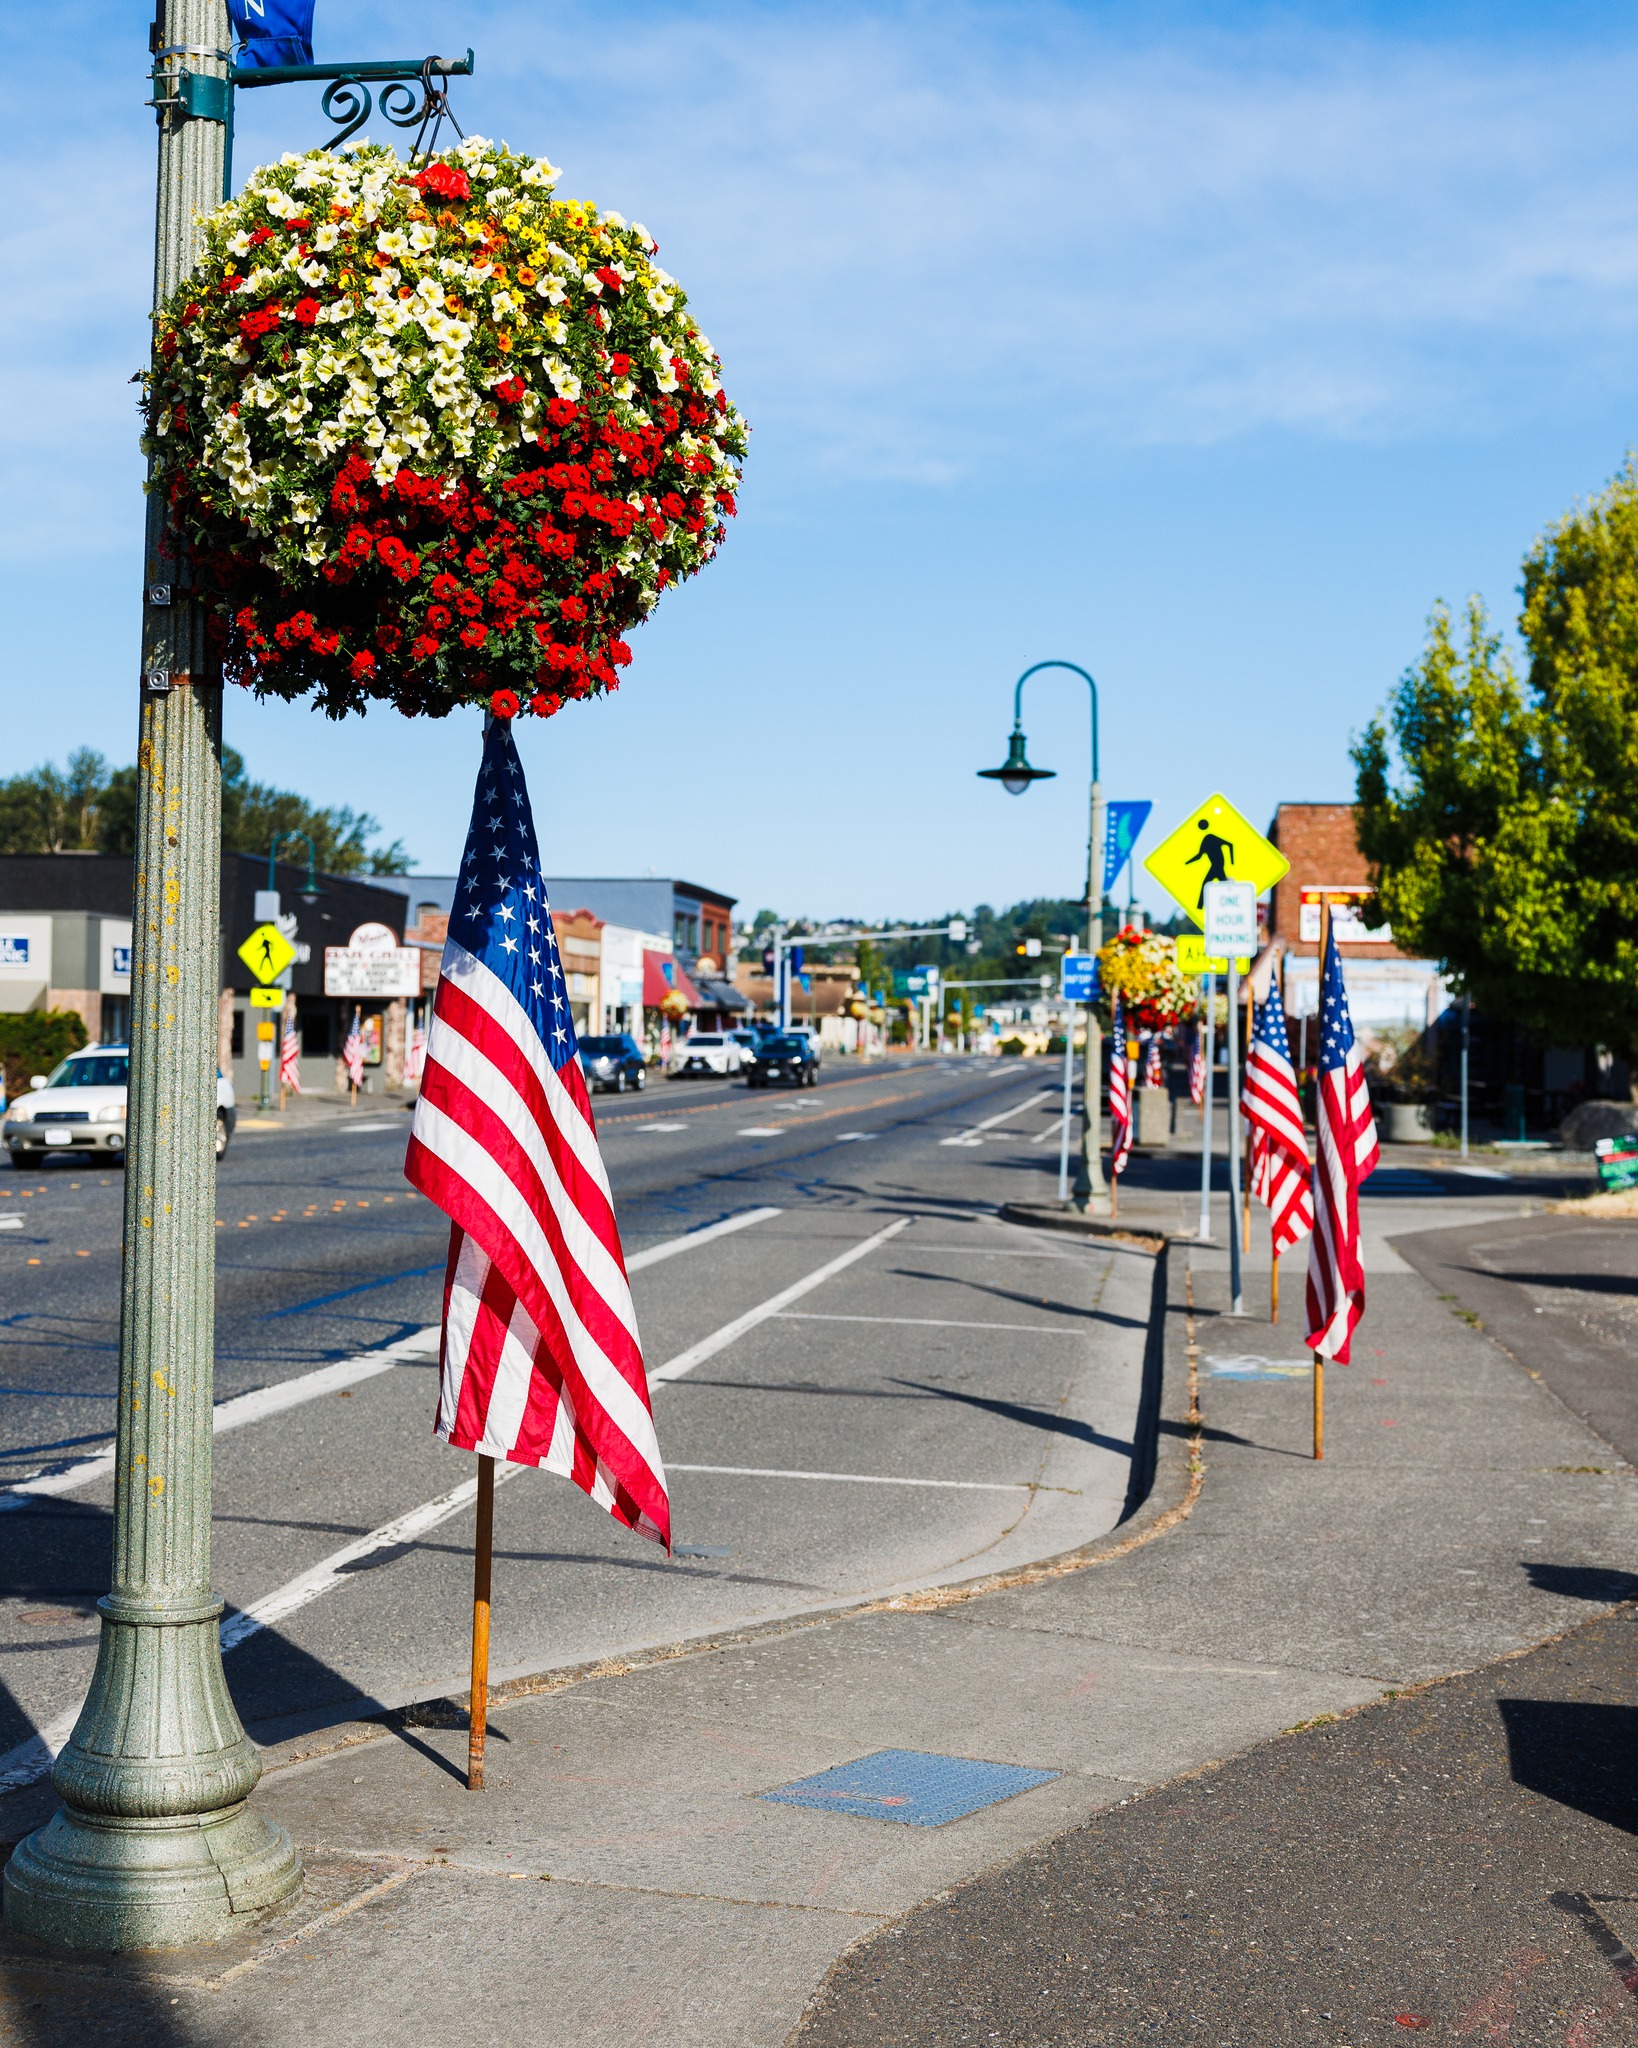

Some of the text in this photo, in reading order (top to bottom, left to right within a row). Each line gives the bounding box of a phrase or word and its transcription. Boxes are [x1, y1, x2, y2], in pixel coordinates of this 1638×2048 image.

[1219, 895, 1240, 906] ONE
[1215, 914, 1245, 925] HOUR
[1210, 933, 1251, 943] PARKING
